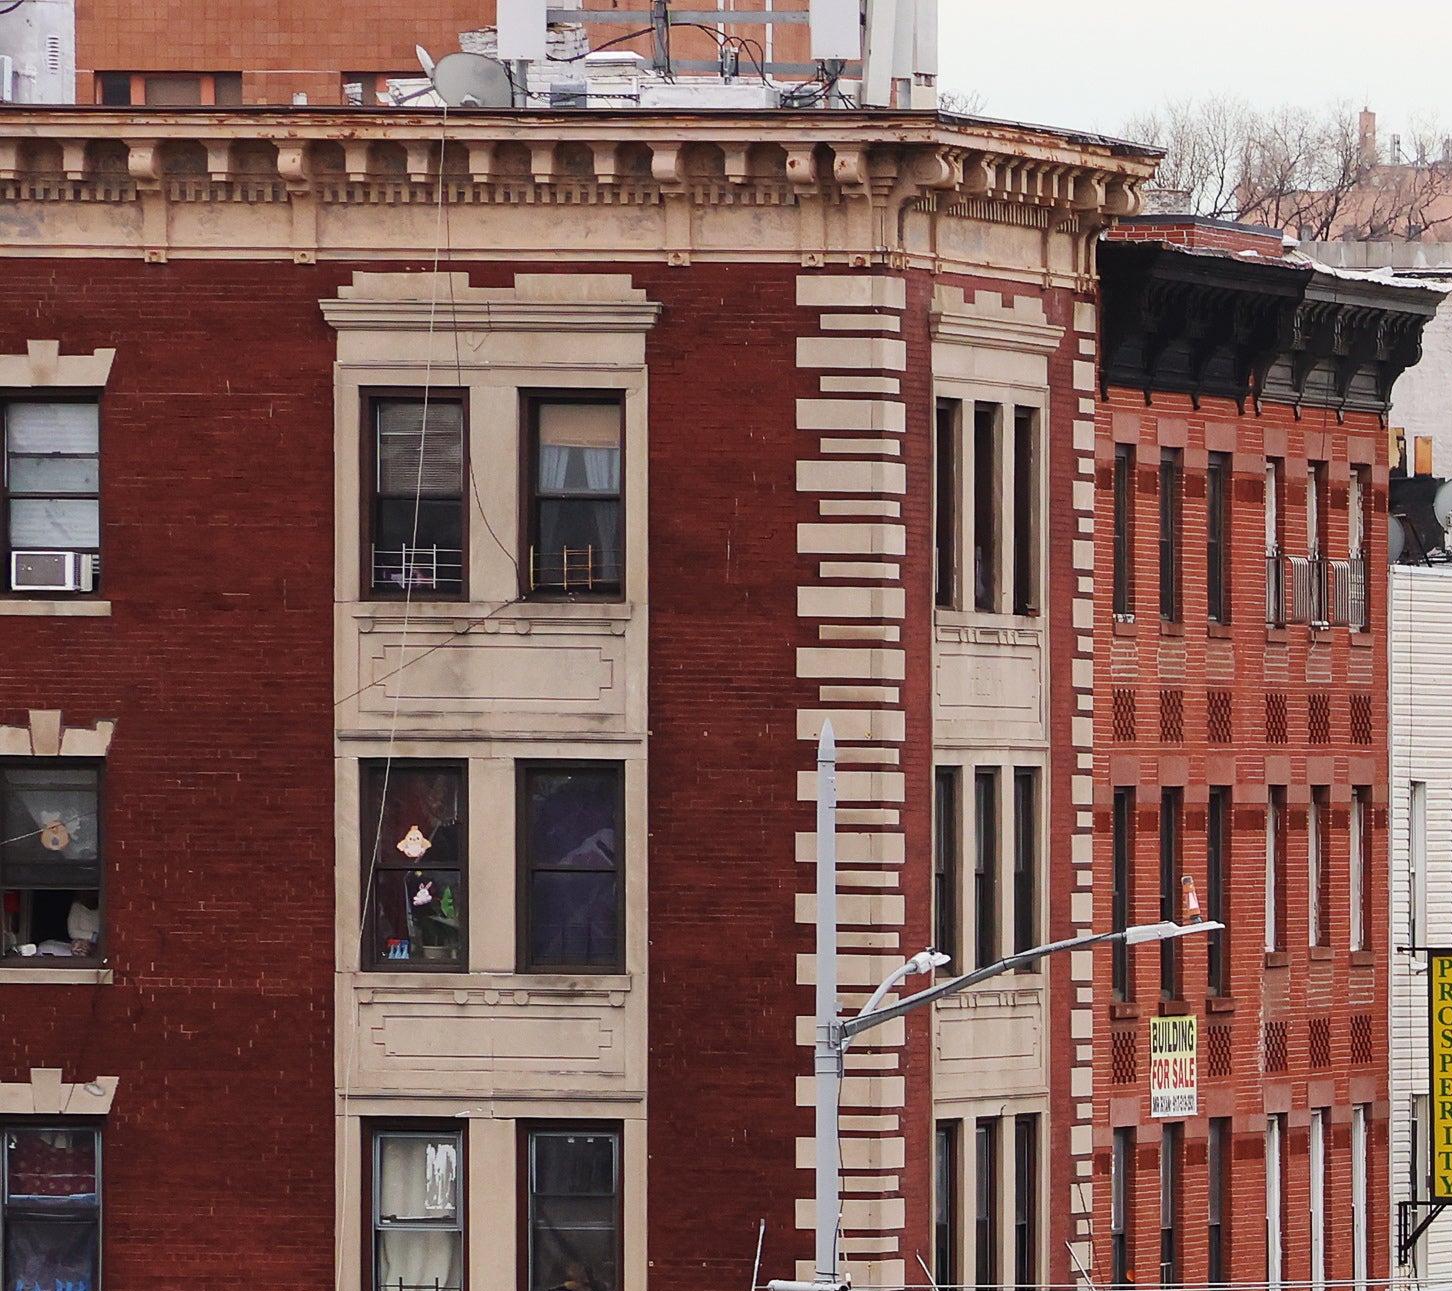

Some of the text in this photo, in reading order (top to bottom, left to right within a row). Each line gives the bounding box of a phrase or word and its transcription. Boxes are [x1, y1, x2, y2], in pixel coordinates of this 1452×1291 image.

[1152, 1020, 1194, 1053] BUILDING
[1152, 1057, 1195, 1090] FOR SALE
